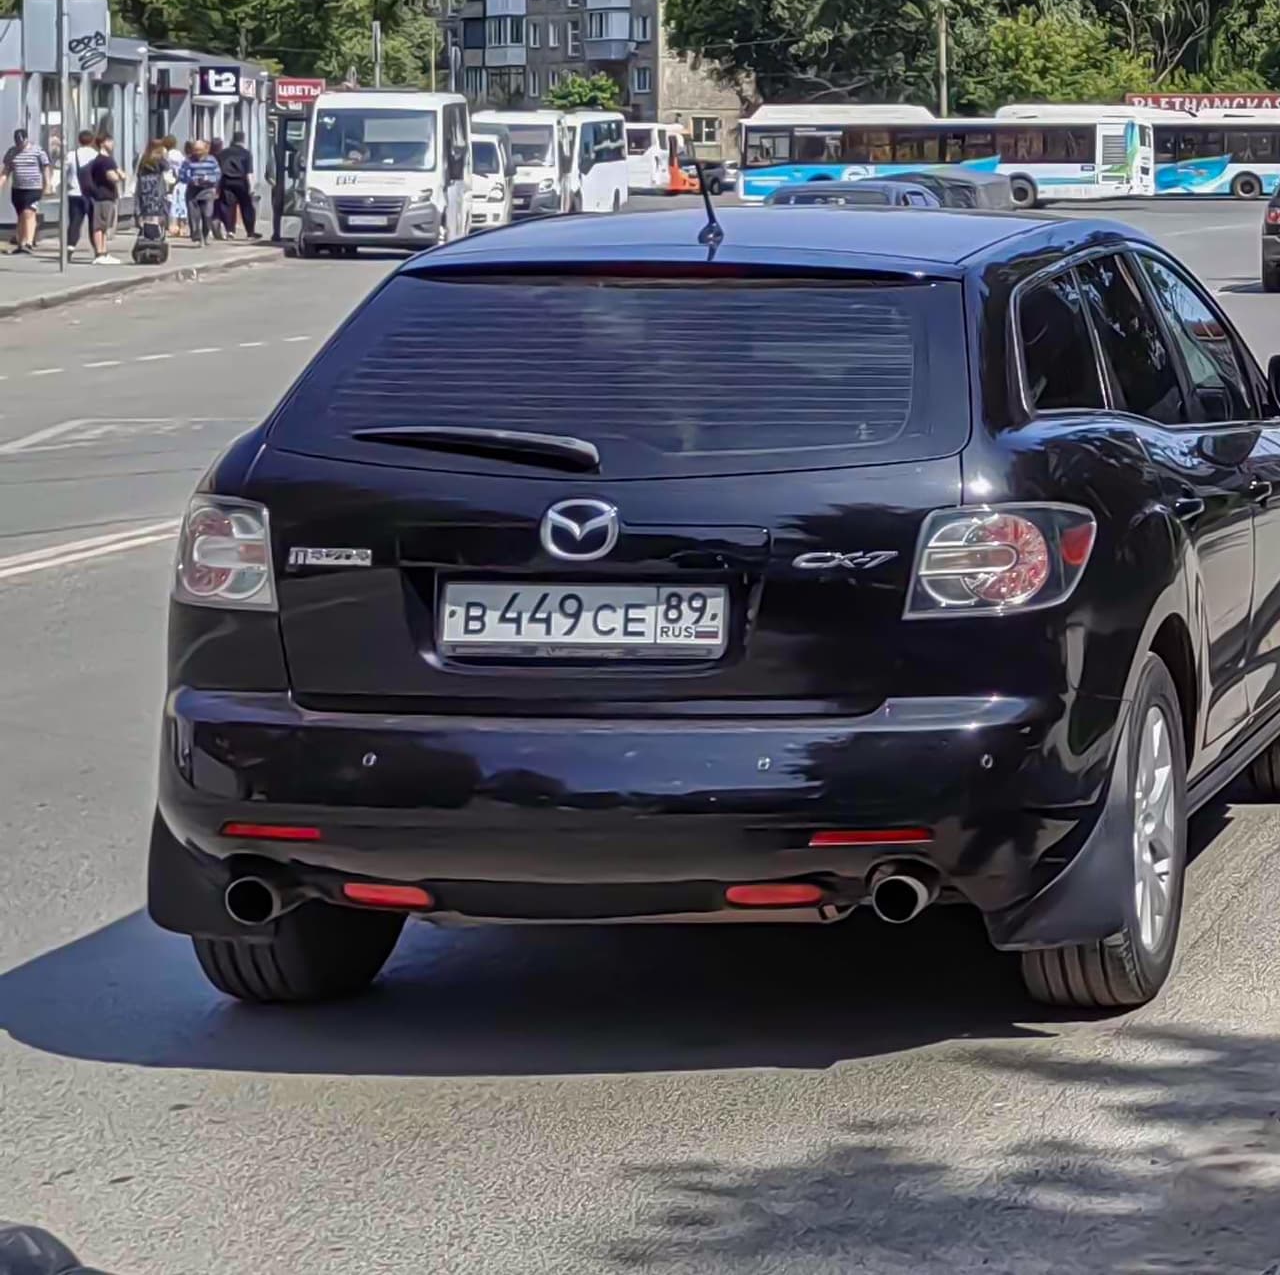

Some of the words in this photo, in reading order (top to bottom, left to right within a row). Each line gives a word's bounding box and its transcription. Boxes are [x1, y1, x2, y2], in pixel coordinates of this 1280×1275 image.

[278, 83, 321, 97] ЦВЕТЫ
[791, 550, 899, 569] CX-7
[662, 591, 708, 626] 89
[659, 625, 693, 639] RUS
